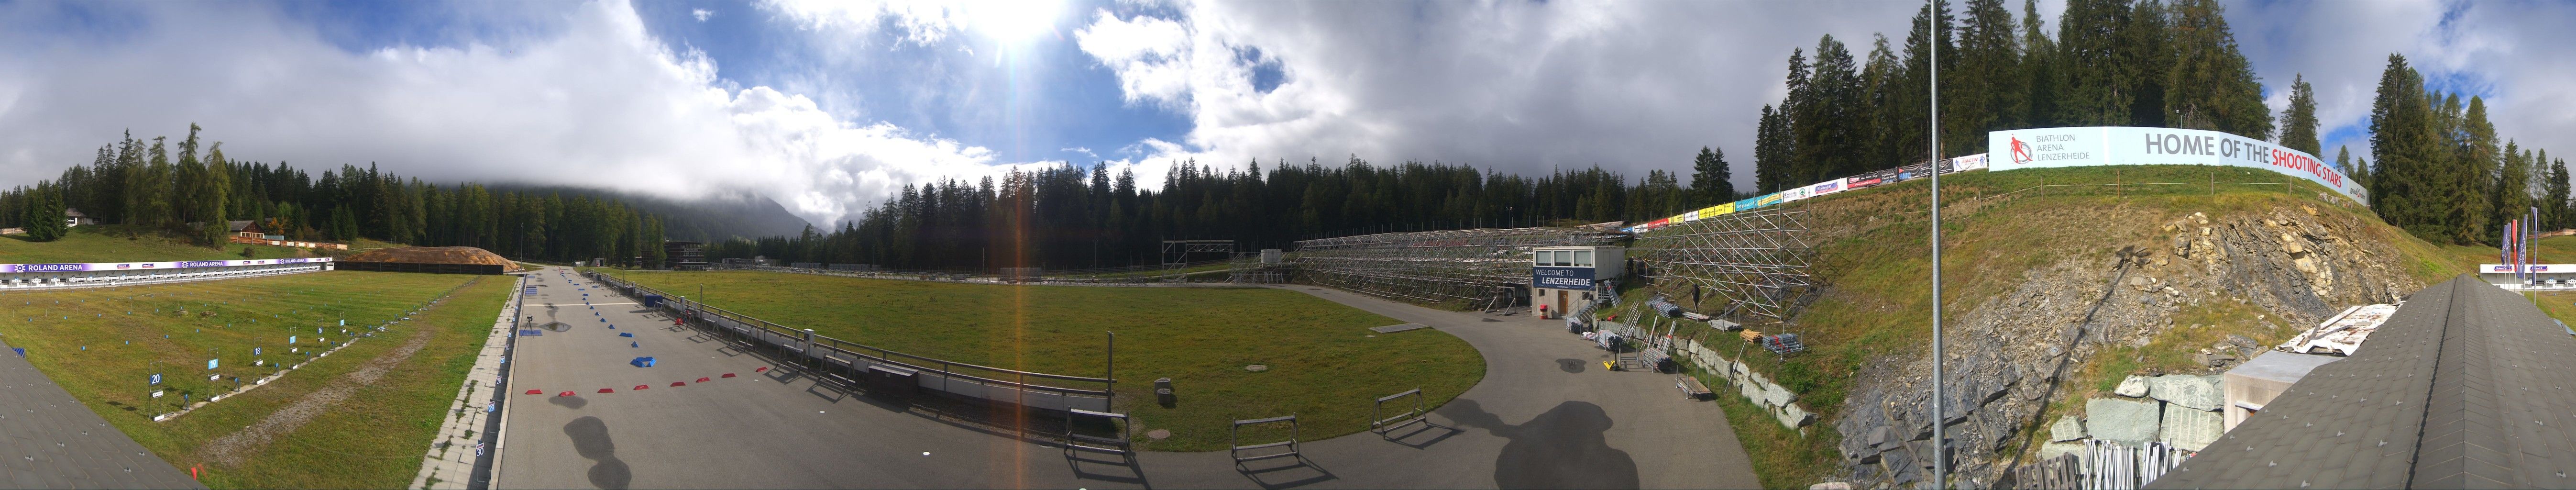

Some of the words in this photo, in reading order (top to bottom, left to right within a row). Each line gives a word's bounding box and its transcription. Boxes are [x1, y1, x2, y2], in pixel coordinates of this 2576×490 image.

[2036, 134, 2075, 143] BIATHLON
[2037, 144, 2064, 152] ARENA
[2038, 152, 2090, 161] LENZERHEIDE
[2146, 133, 2215, 156] HOME
[2221, 138, 2241, 158] OF
[2244, 142, 2269, 164] THE
[2272, 149, 2321, 177] SHOOTING
[2323, 167, 2342, 188] STARS
[1542, 277, 1591, 286] LENZERHEIDE
[255, 347, 260, 355] 18
[210, 360, 216, 368] 19
[152, 374, 160, 384] 20
[476, 447, 484, 457] 30
